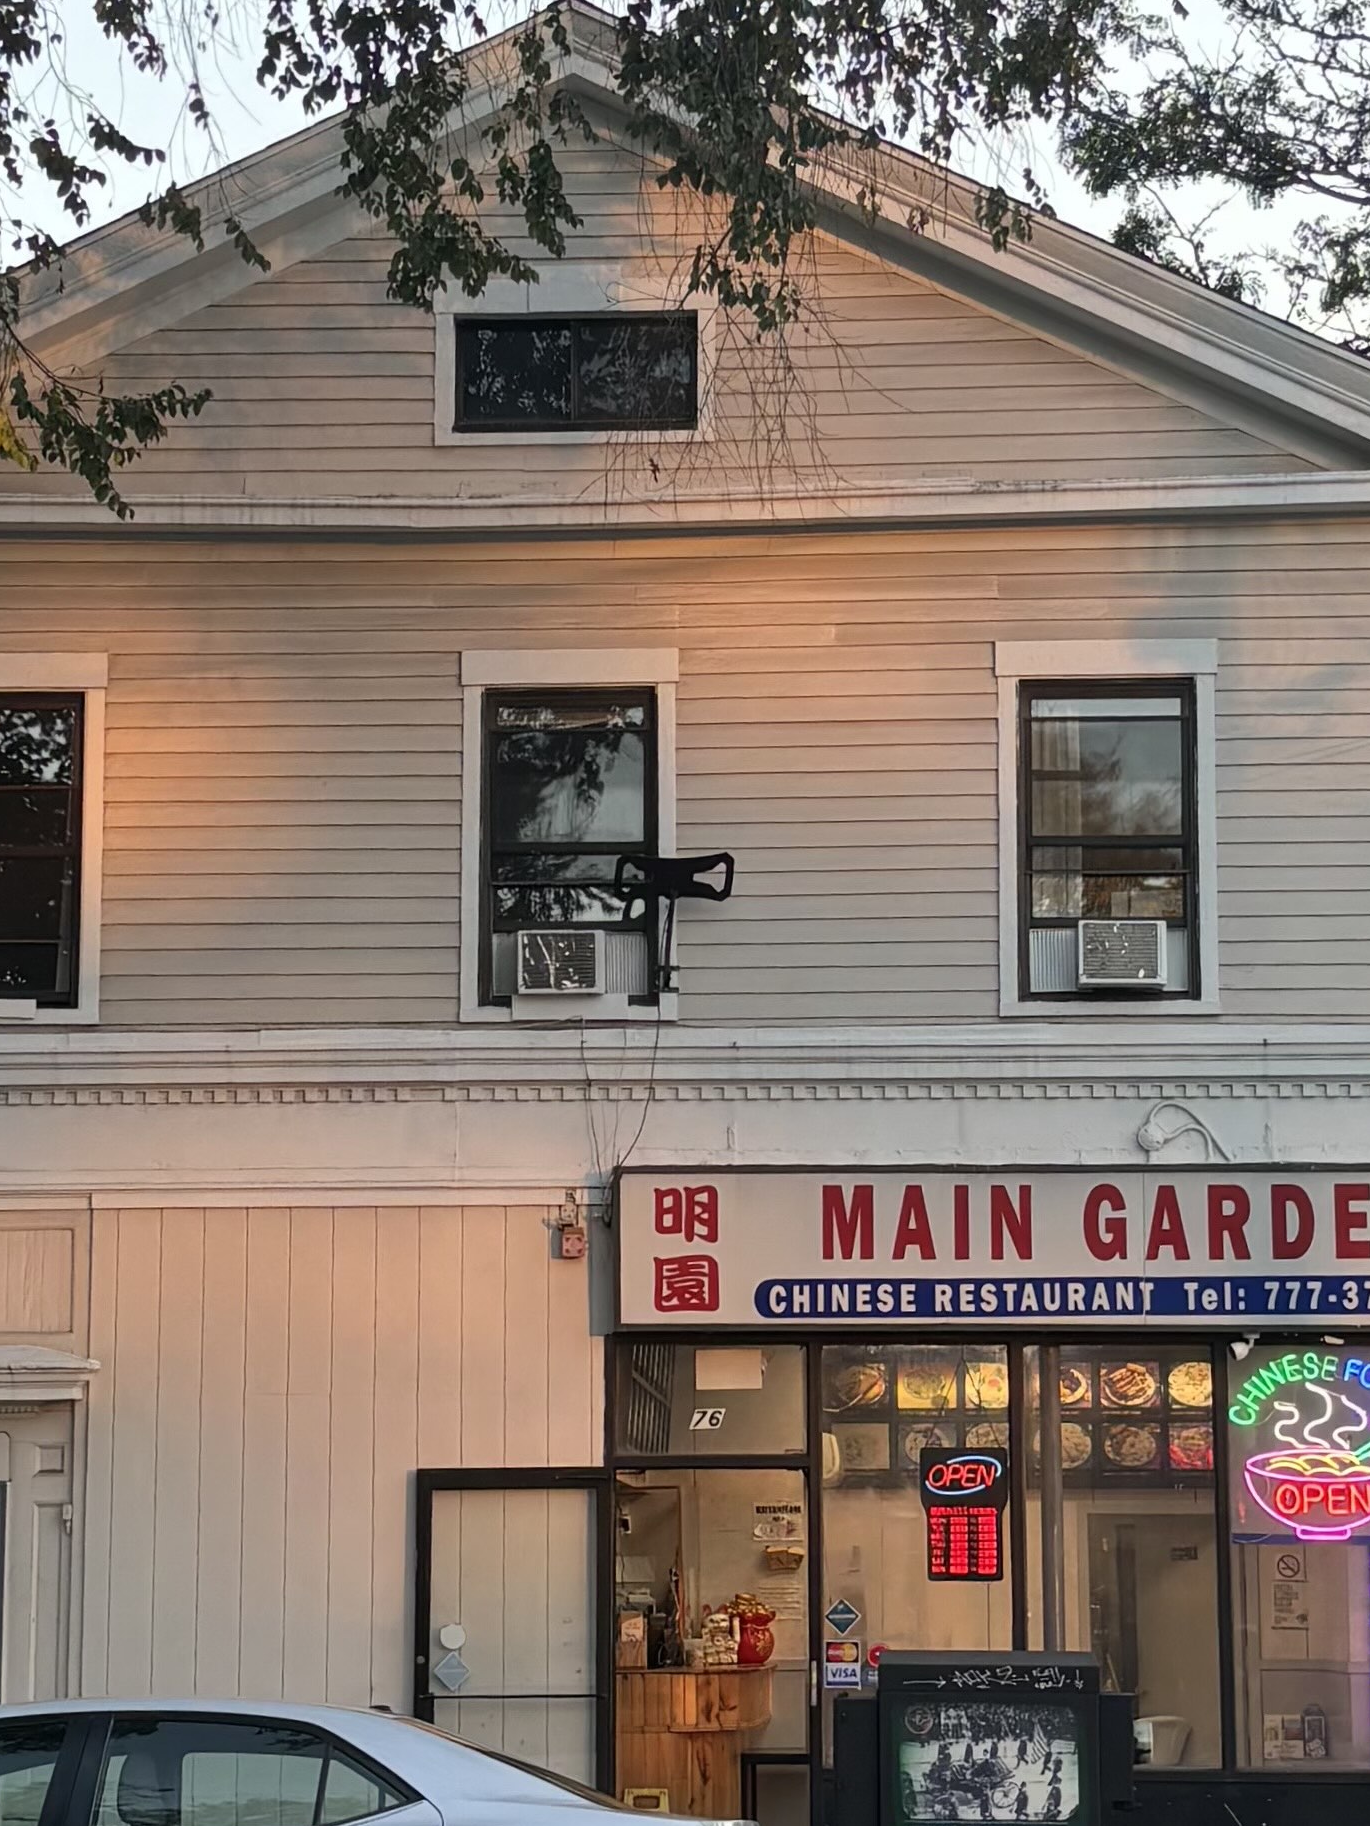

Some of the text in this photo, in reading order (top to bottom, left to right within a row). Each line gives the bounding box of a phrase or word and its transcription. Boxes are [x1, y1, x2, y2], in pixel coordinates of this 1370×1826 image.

[821, 1184, 1033, 1261] MAIN
[768, 1282, 918, 1314] CHINESE
[933, 1281, 1155, 1313] RESTAURANT
[1183, 1281, 1247, 1312] Tel:
[1228, 1352, 1339, 1426] CHINESE
[692, 1409, 724, 1428] 76
[929, 1464, 996, 1487] OPEN
[830, 1667, 858, 1679] VISA
